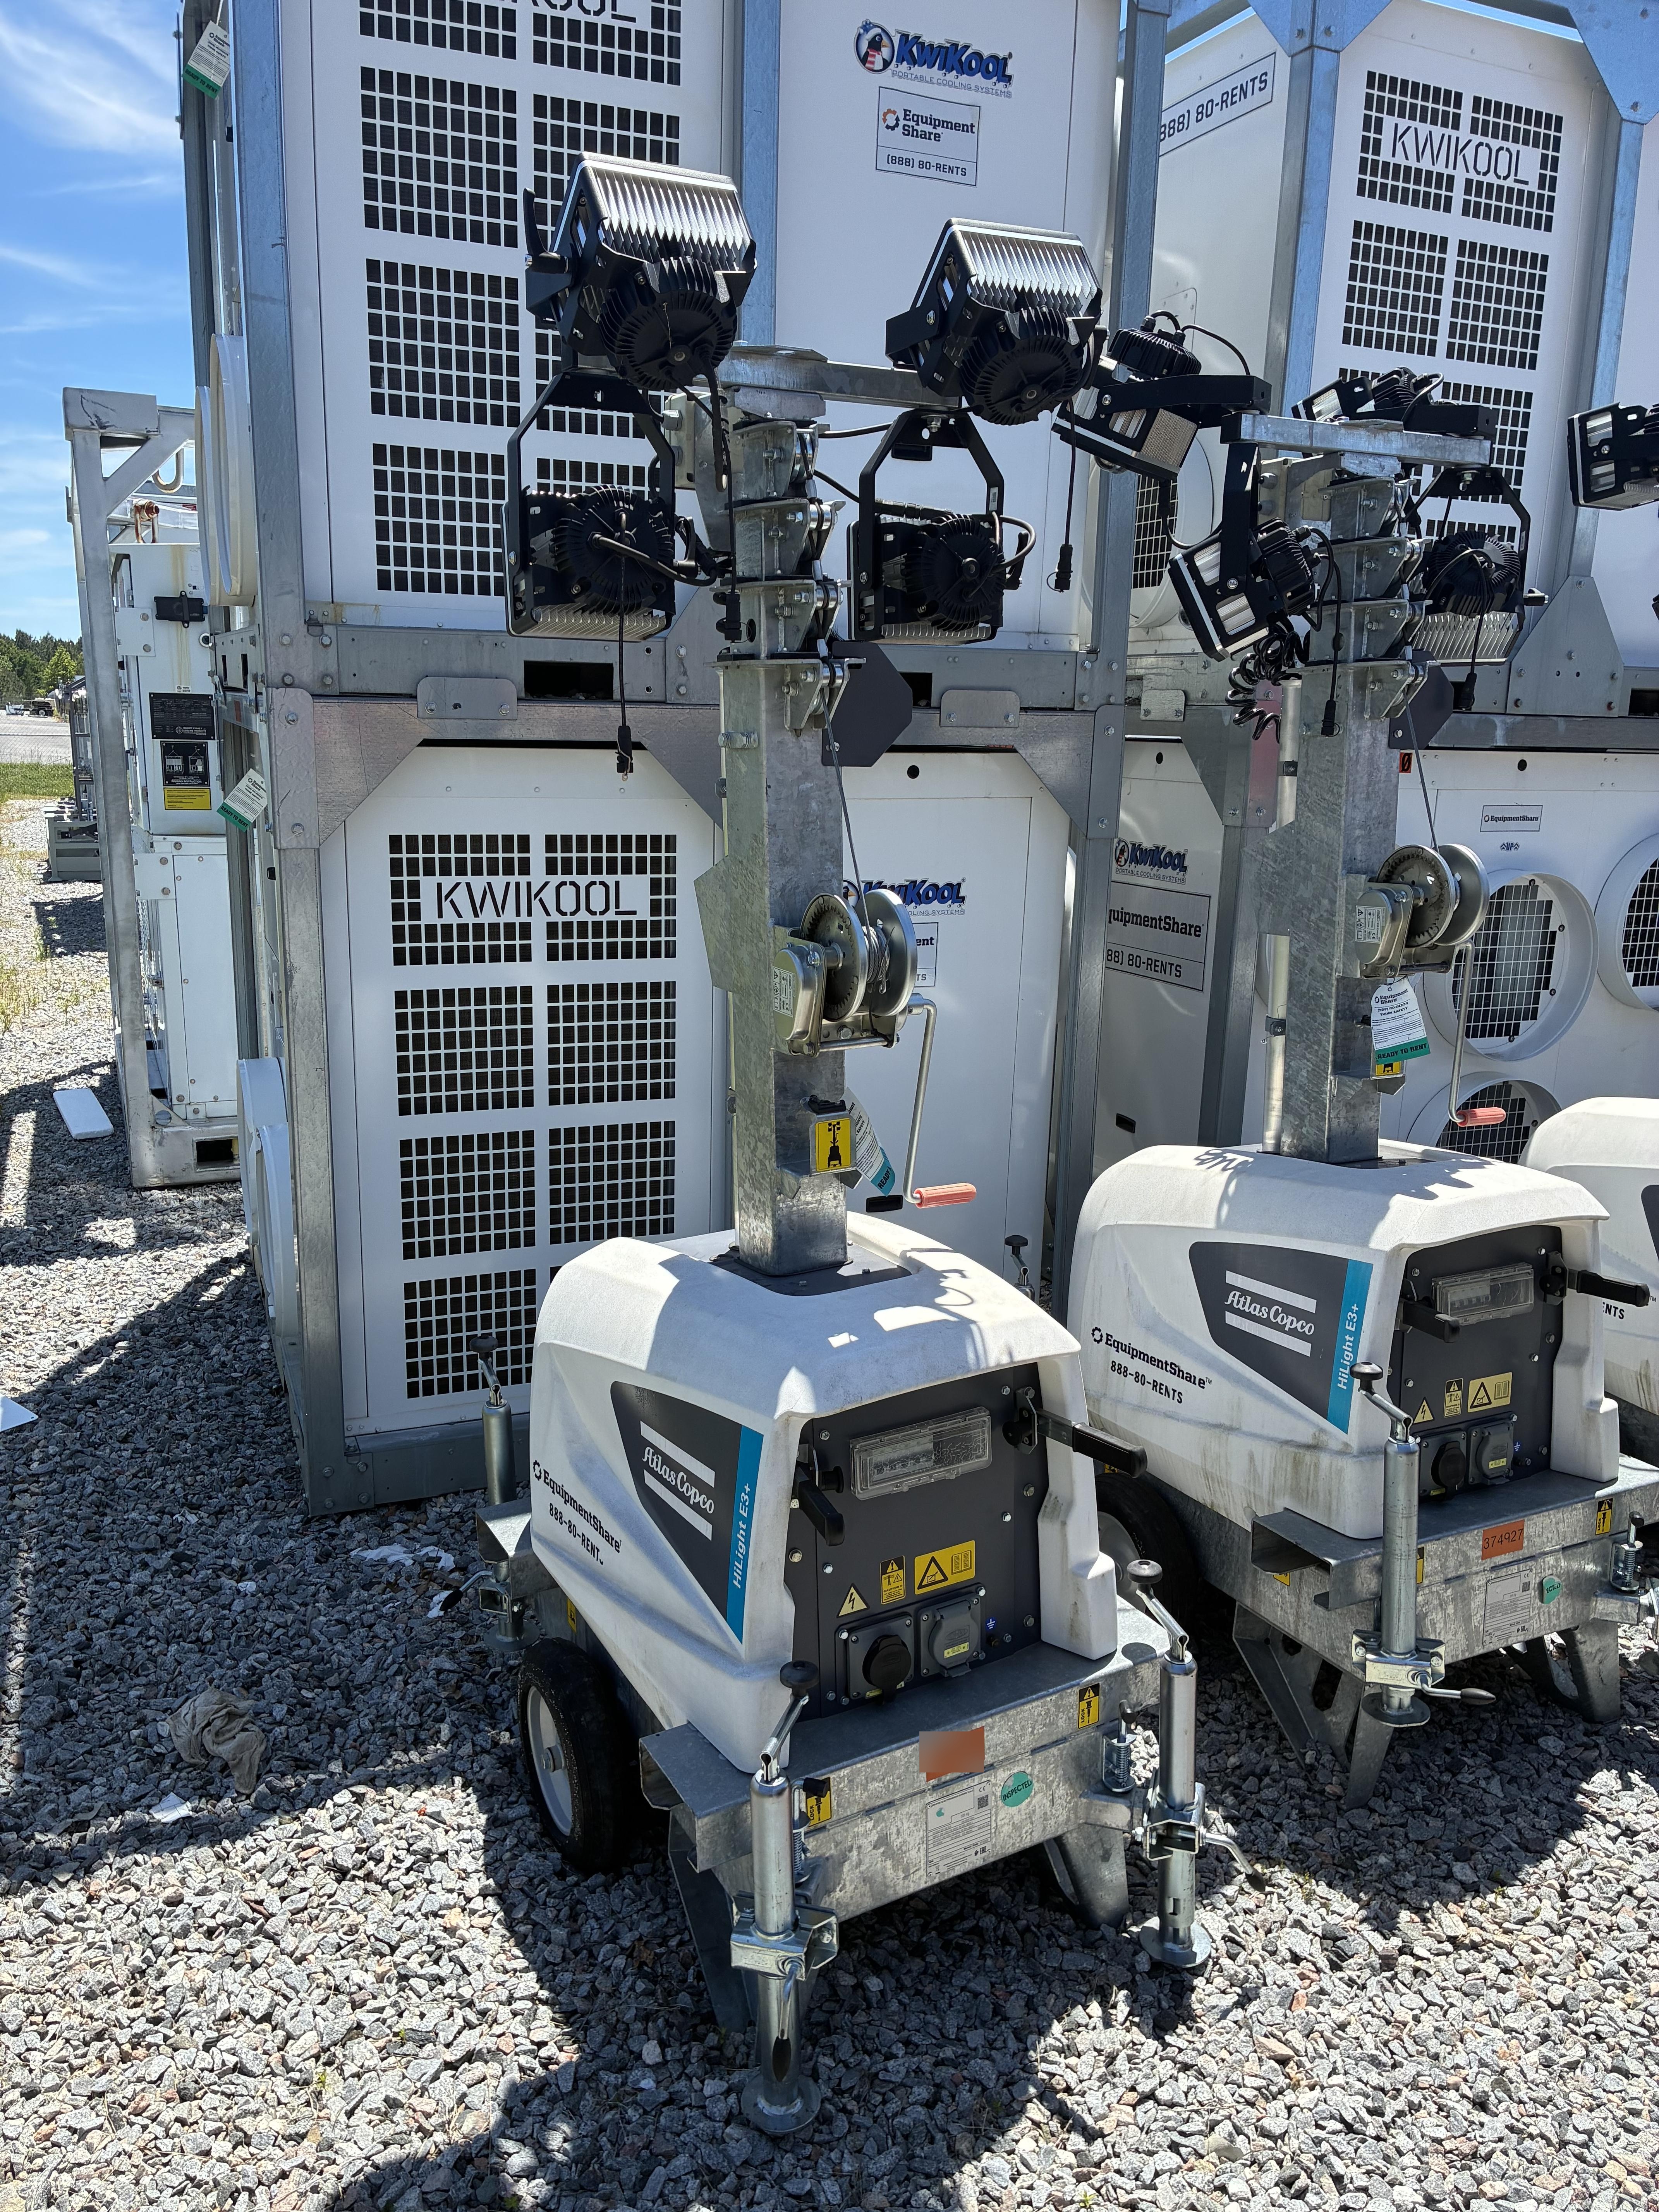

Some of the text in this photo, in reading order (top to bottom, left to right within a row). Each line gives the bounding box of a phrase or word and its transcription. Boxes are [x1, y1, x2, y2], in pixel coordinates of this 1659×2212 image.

[891, 70, 1012, 98] PORTABLE COOLING SYSTEMS
[1159, 71, 1268, 143] 888) 80-RENTS
[902, 108, 975, 134] Equipment
[902, 124, 941, 142] Share
[887, 154, 967, 177] (888) 80-RENTS
[1392, 123, 1529, 186] KWIKOOL
[220, 805, 233, 816] READY
[1162, 875, 1185, 883] SYSTEMS
[436, 880, 637, 919] KWIKOOL
[1106, 949, 1182, 978] 88) 80-RENTS
[1377, 1050, 1398, 1059] READY
[1410, 1042, 1427, 1052] RENT
[877, 1169, 891, 1189] READY
[1337, 1304, 1358, 1390] HiLight E3+
[1111, 1360, 1183, 1404] 888-80-RENTS
[733, 1483, 752, 1589] HiLight E3+
[1484, 1528, 1524, 1549] 374927
[1002, 1780, 1032, 1801] INSPECTED
